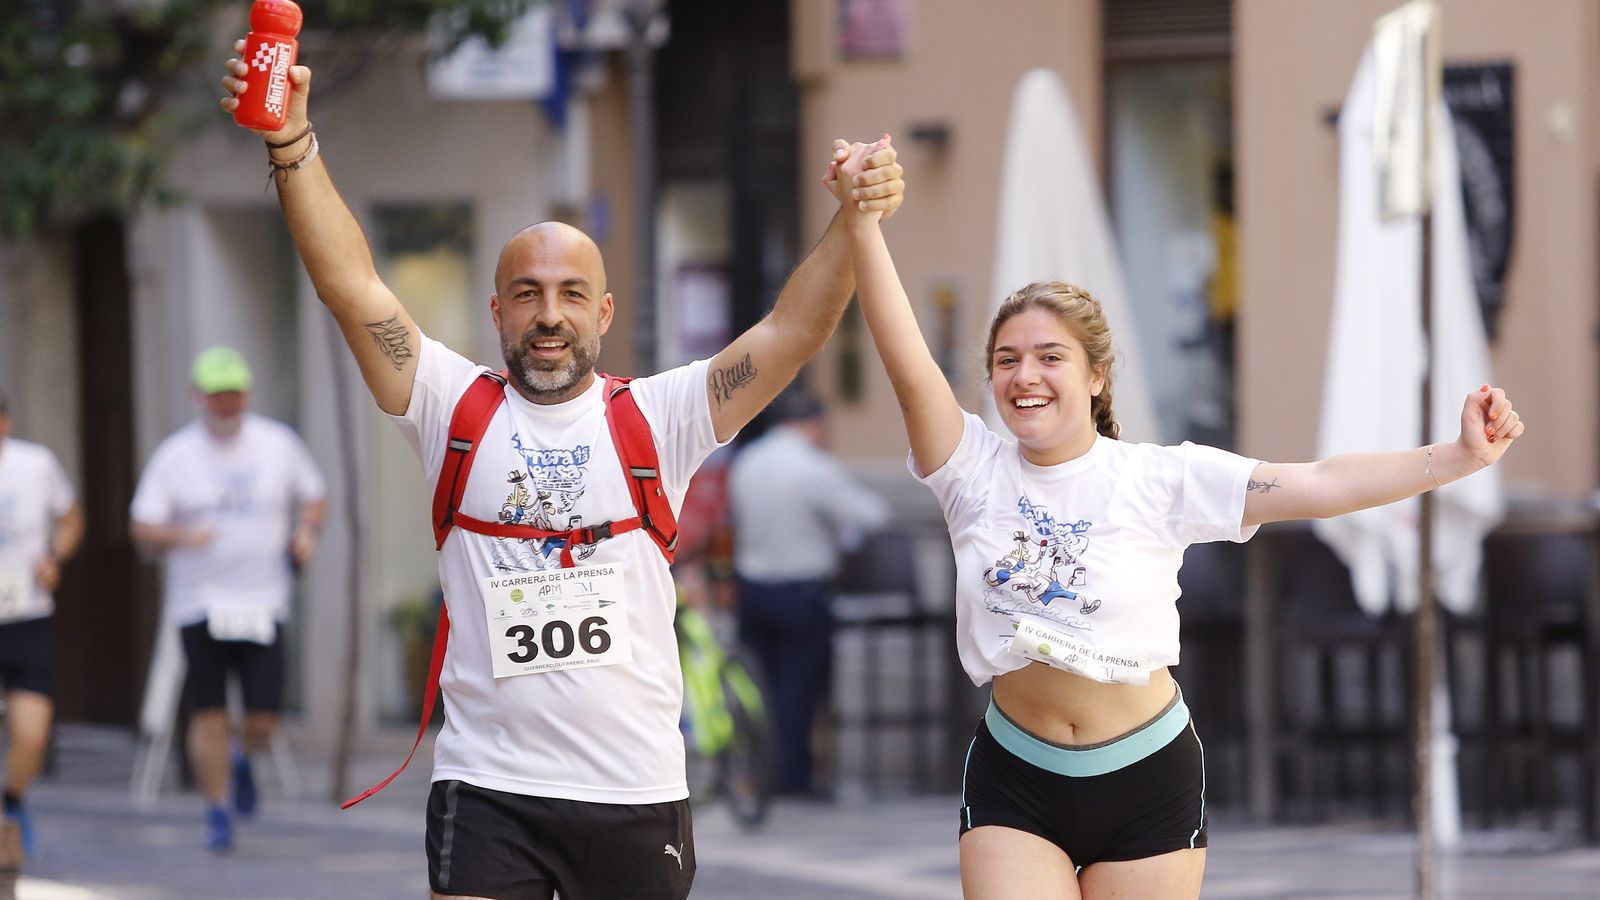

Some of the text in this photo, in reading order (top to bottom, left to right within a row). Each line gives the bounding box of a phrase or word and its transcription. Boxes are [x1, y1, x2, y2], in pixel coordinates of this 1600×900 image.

[268, 42, 292, 105] NutriSport
[490, 567, 615, 589] IV CARRERA DE LA PRENSA
[538, 584, 562, 597] APM
[505, 616, 611, 664] 306
[1025, 625, 1140, 669] IV CARRERA DE LA PRENSA
